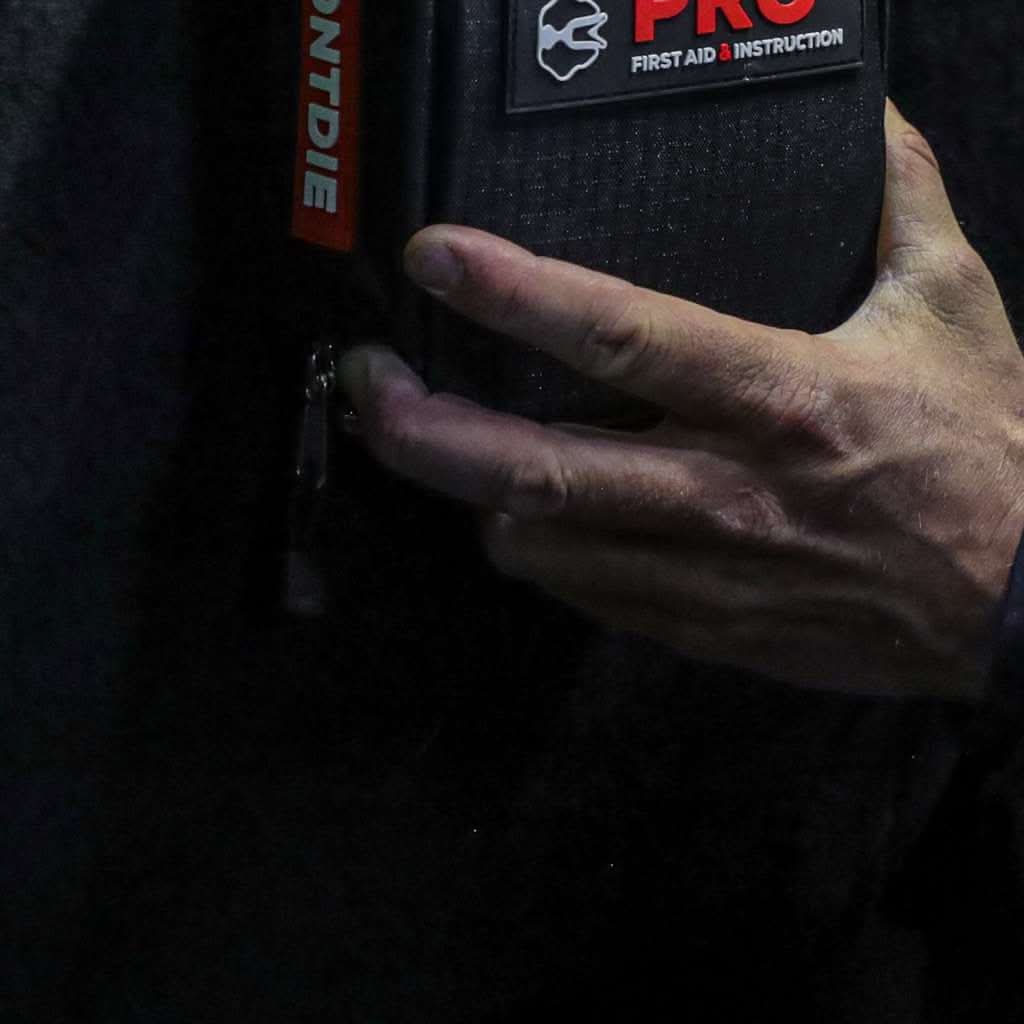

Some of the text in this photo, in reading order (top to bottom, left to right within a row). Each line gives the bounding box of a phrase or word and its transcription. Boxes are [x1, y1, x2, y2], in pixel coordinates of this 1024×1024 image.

[631, 28, 844, 72] FIRST AID & INSTRUCTION
